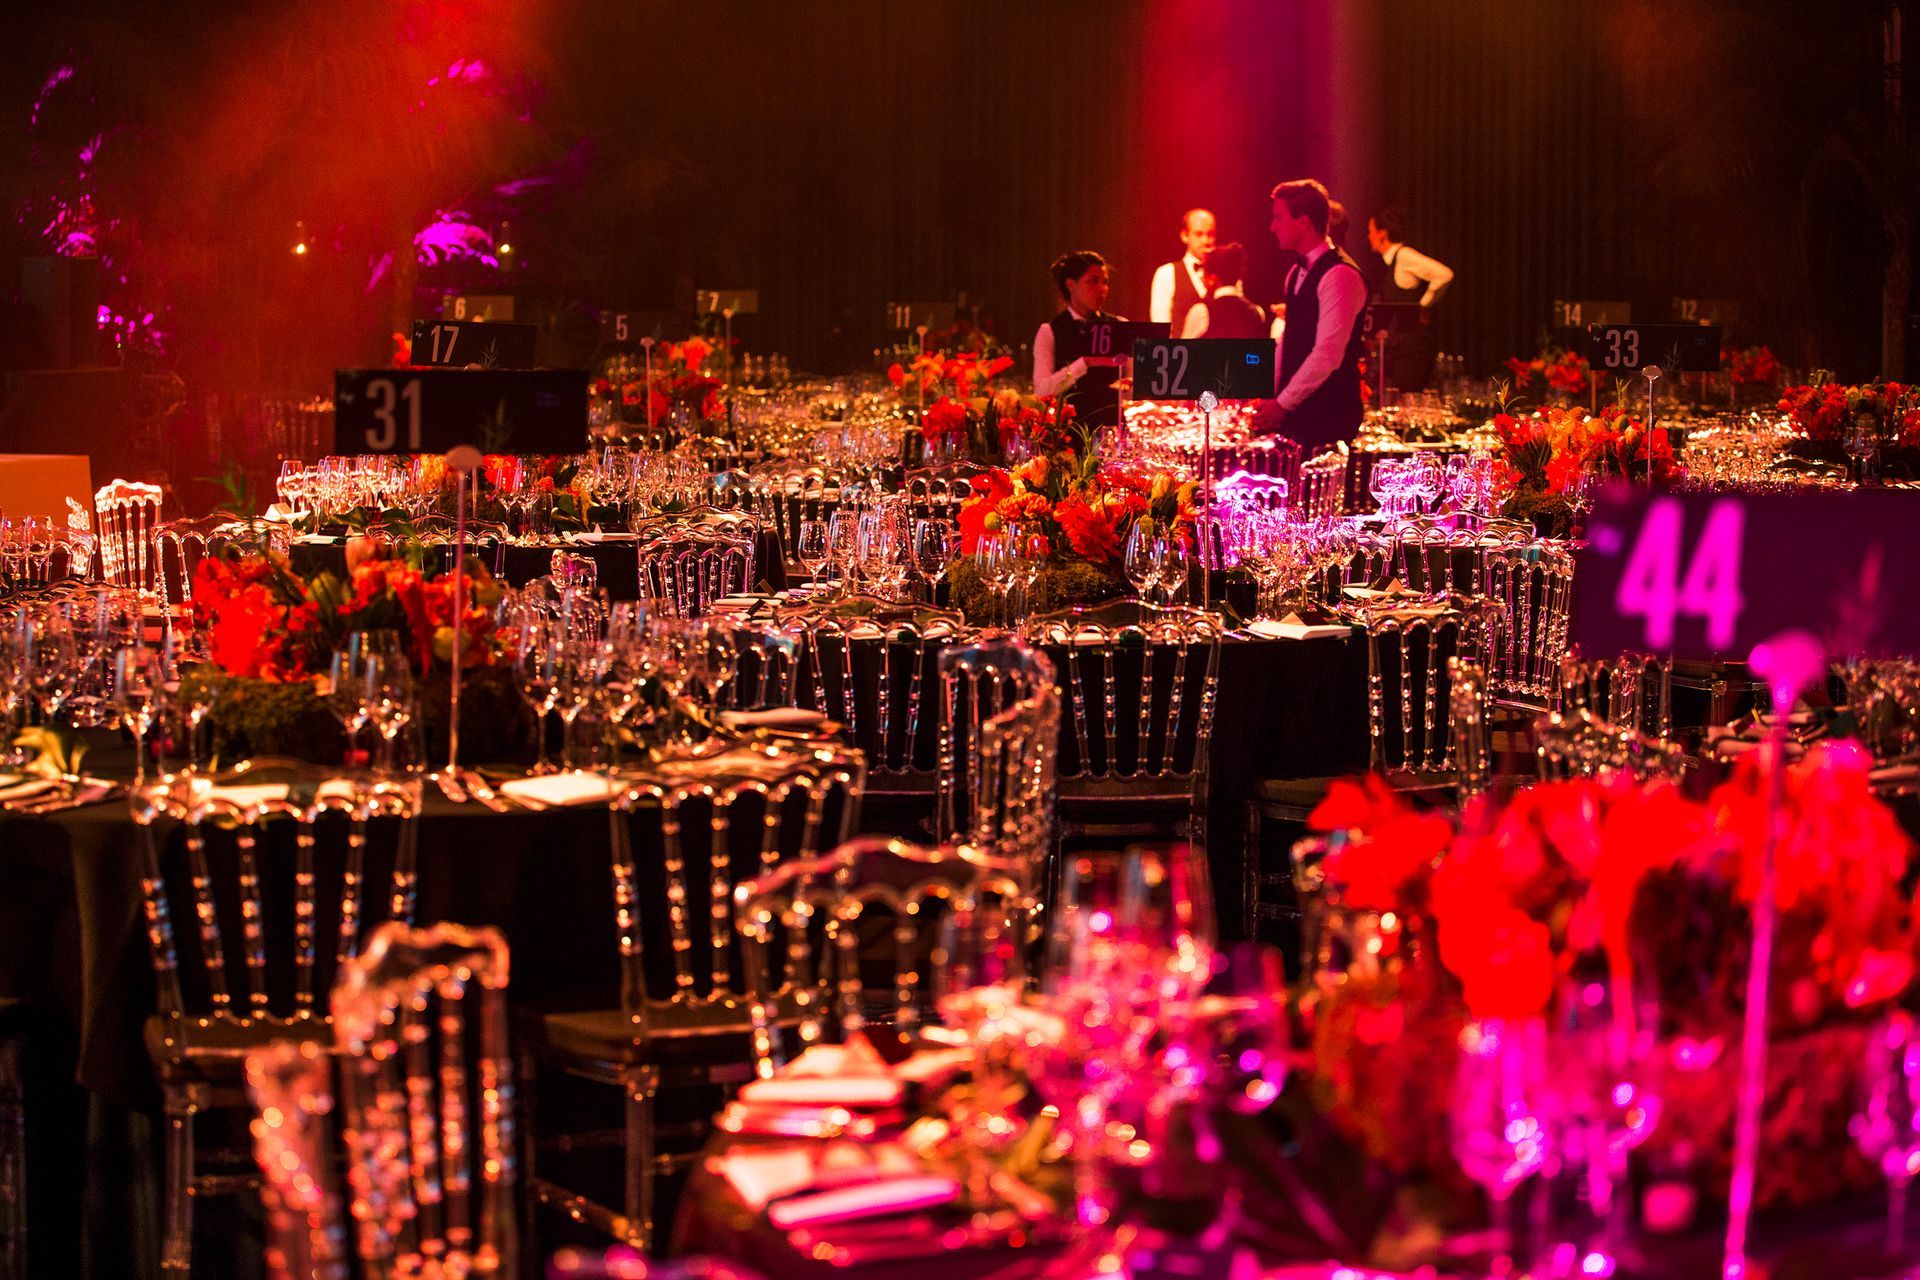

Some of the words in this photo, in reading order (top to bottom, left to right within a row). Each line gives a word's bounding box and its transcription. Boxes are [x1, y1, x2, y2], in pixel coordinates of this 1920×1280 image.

[454, 297, 466, 320] 6
[709, 292, 719, 312] 7
[895, 303, 911, 328] 11
[1564, 303, 1581, 327] 14
[1681, 299, 1697, 320] 12
[614, 314, 627, 341] 5
[1363, 306, 1374, 332] 5
[431, 325, 459, 363] 17
[1090, 324, 1112, 354] 16
[1604, 329, 1639, 368] 33
[1151, 344, 1188, 396] 32
[365, 378, 421, 451] 31
[1614, 496, 1744, 650] 44
